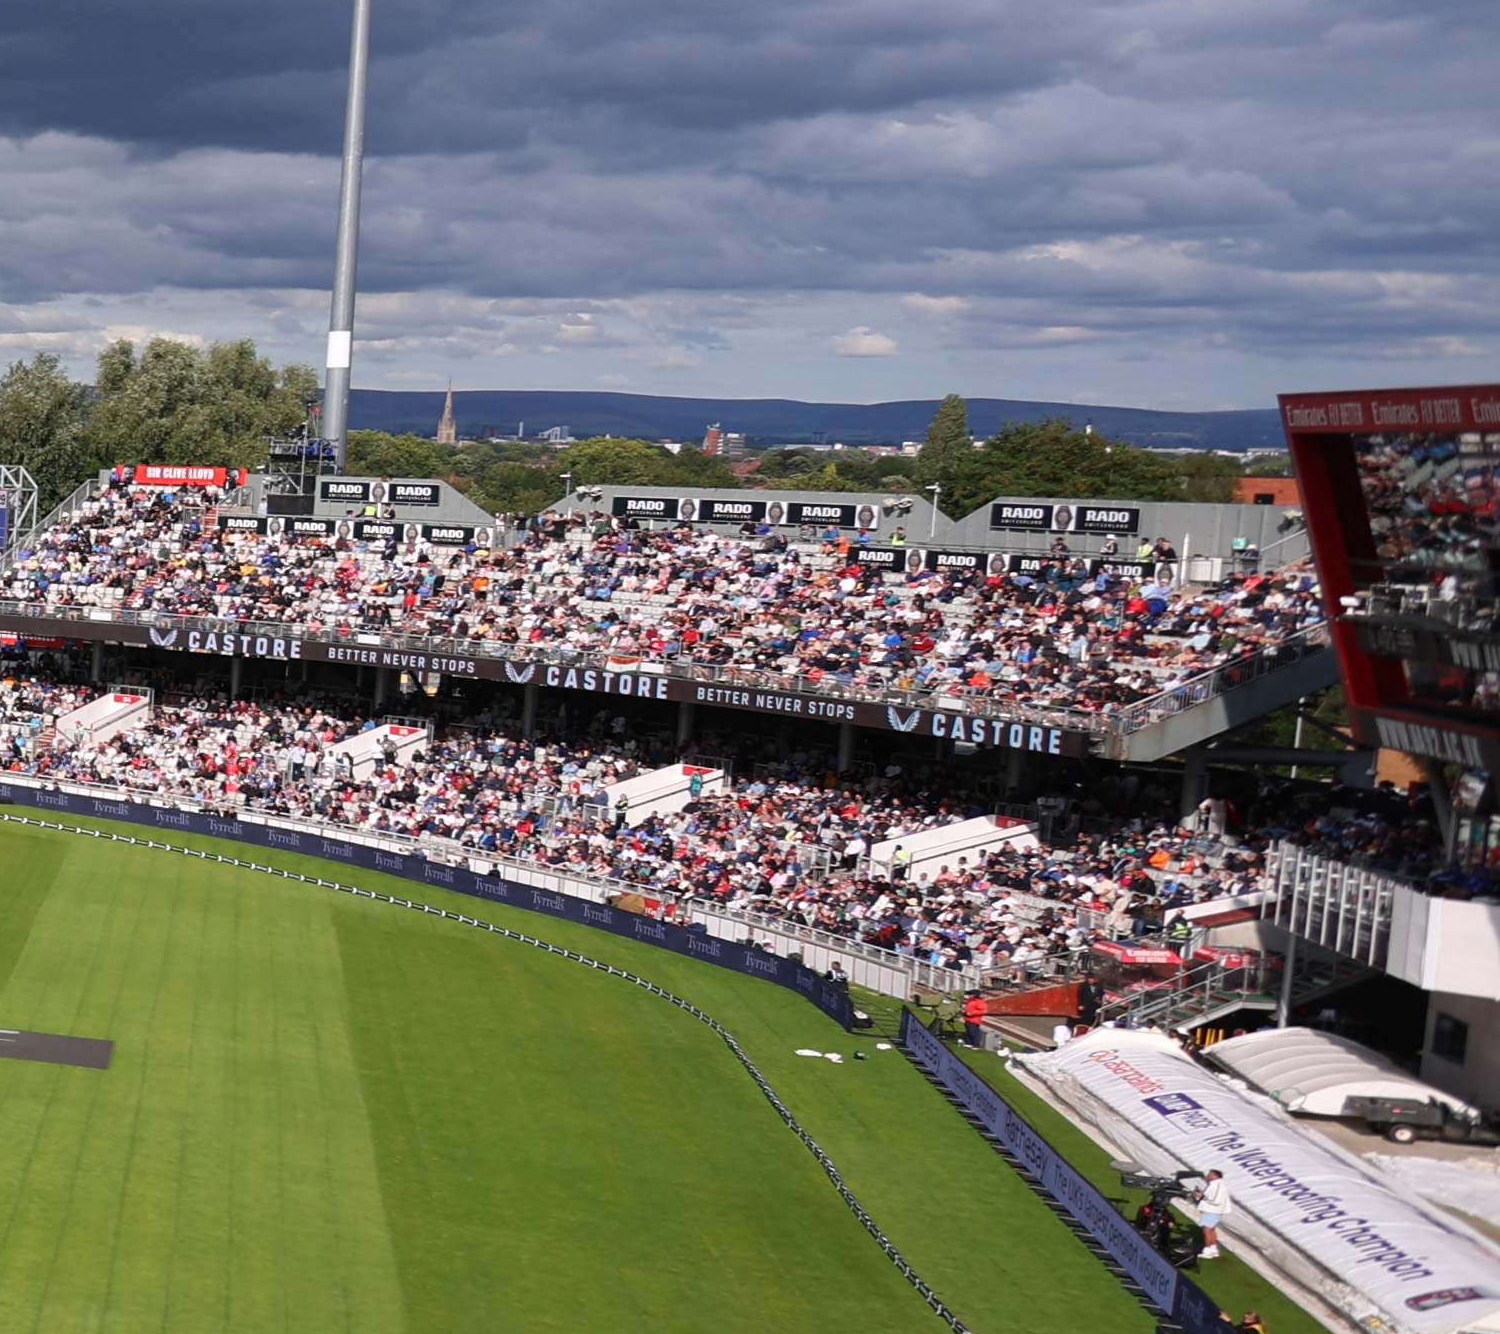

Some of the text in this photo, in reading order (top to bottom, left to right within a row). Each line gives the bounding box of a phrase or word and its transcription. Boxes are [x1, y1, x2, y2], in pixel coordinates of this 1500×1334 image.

[1371, 401, 1419, 425] Emirates
[146, 466, 214, 479] SIR CLIVE LLOYD
[329, 484, 362, 493] RADO
[396, 486, 431, 496] RADO
[627, 499, 665, 511] RADO
[714, 502, 752, 514] RADO
[802, 506, 840, 517] RADO
[1002, 506, 1043, 519] RADO
[1086, 509, 1130, 522] RADO
[227, 518, 258, 528] RADO
[294, 521, 326, 532] RADO
[363, 525, 394, 534] RADO
[432, 528, 464, 539] RADO
[188, 630, 302, 659] CASTORE
[328, 647, 475, 673] BETTER NEVER STOPS
[546, 666, 669, 699] CASTORE
[697, 687, 855, 720] BETTER NEVER STOPS
[931, 713, 1063, 755] CASTORE
[153, 808, 189, 826] Tyrrells
[633, 917, 665, 942] Tyrrells
[744, 949, 778, 975] Tyrrells
[1005, 1109, 1050, 1180] Rothesay
[1203, 1130, 1435, 1283] The Waterproofing Champion
